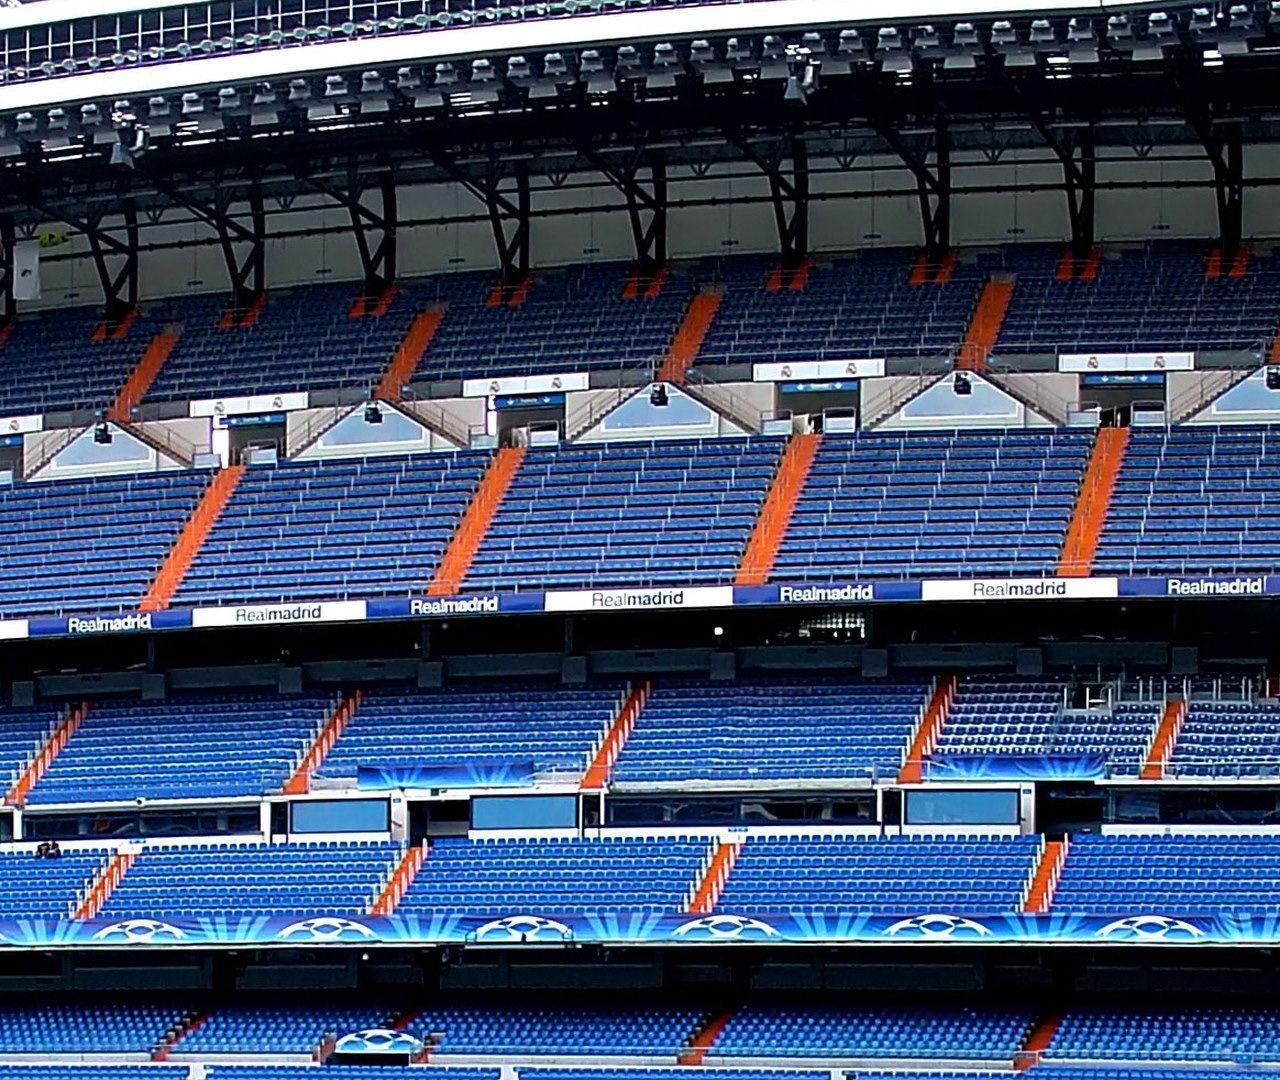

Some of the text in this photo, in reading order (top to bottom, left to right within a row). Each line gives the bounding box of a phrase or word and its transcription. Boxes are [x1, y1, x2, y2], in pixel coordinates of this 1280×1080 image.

[779, 585, 873, 601] Realmadrid
[973, 581, 1066, 596] Realmadrid
[1167, 578, 1262, 595] Realmadrid
[410, 597, 498, 615] Realmadrid
[592, 591, 683, 606] Realmadrid
[236, 605, 321, 622] Realmadrid
[68, 613, 151, 633] Realmadrid
